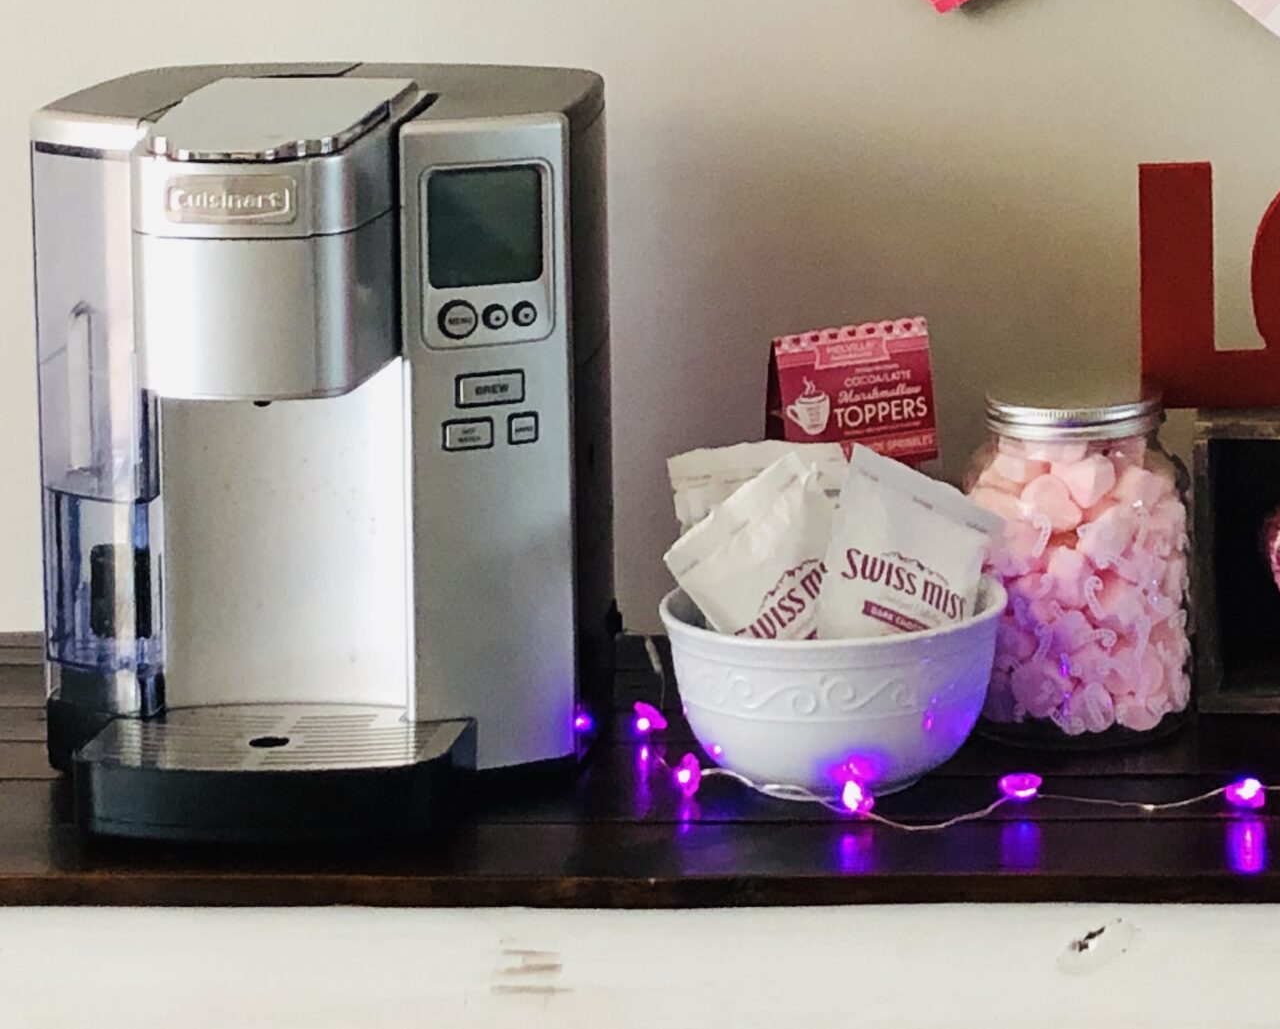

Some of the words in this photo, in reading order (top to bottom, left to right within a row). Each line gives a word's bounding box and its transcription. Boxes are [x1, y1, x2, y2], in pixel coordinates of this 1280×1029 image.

[169, 188, 282, 212] Cuisinart
[474, 383, 510, 396] BREW
[837, 382, 923, 406] Marshmallow
[832, 395, 929, 429] TOPPERS
[841, 547, 917, 596] SWISS
[734, 586, 807, 640] WISS
